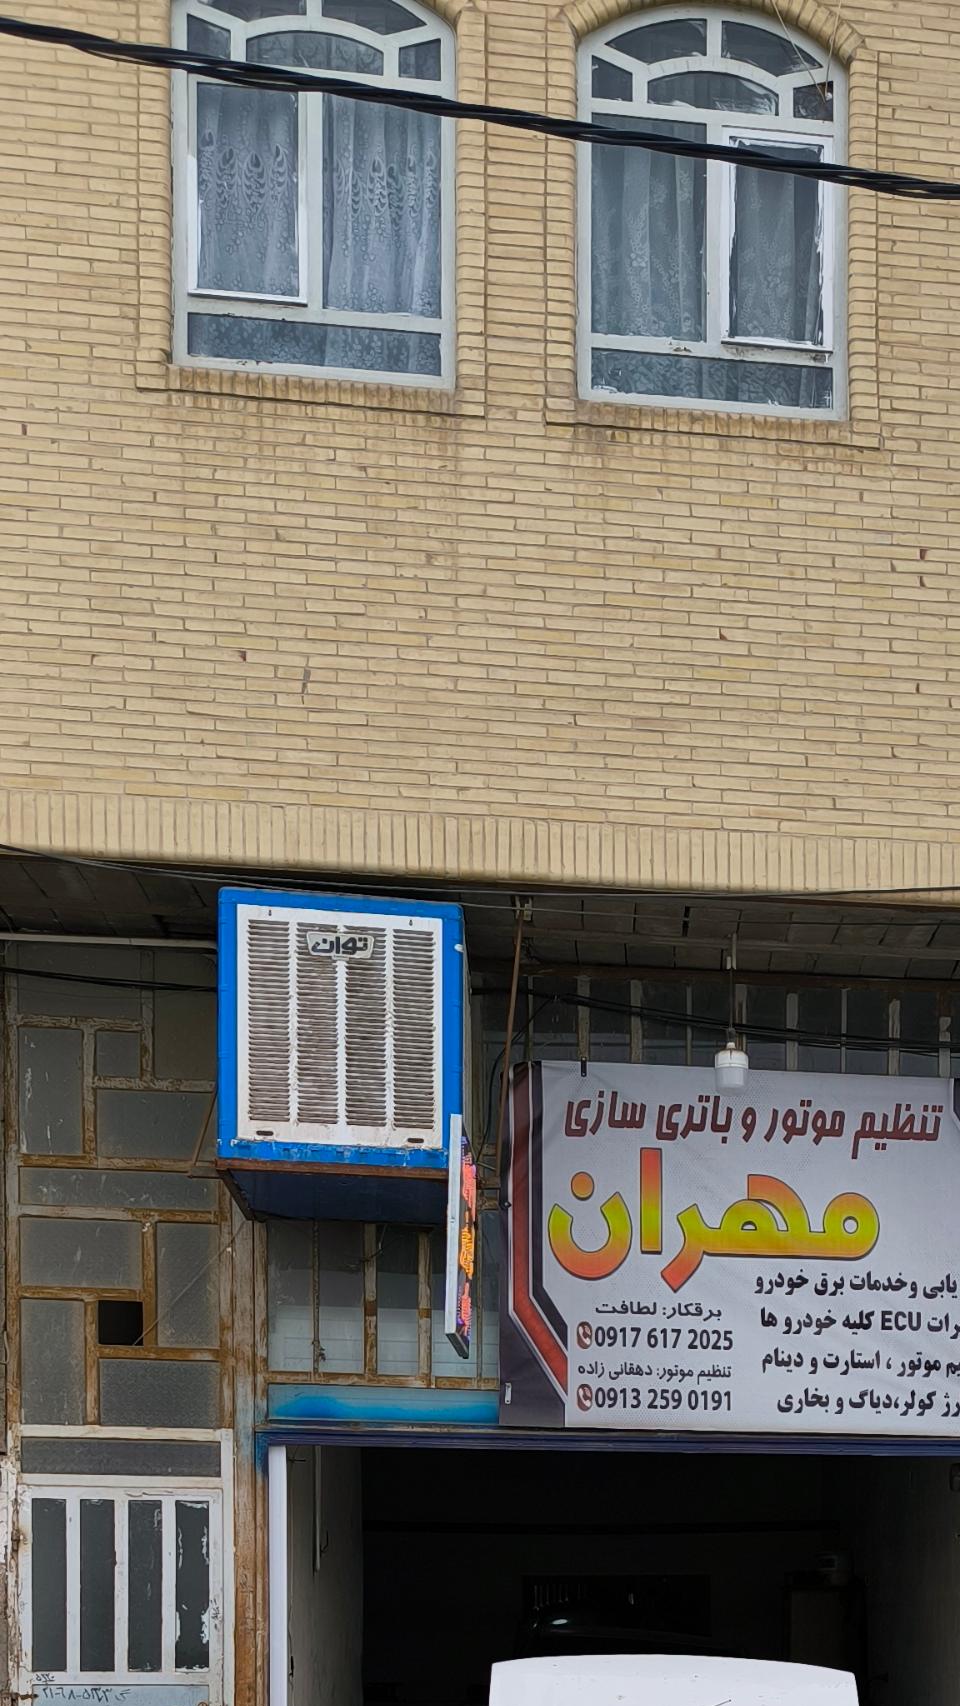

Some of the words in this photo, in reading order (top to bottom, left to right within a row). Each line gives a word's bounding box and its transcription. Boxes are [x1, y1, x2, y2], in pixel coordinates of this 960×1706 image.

[311, 936, 368, 955] توان
[565, 1090, 646, 1137] سازی
[656, 1095, 733, 1144] باتری
[741, 1107, 756, 1143] و
[764, 1100, 845, 1145] موتور
[852, 1103, 943, 1159] تنظیم
[547, 1148, 880, 1293] مهران
[754, 1269, 809, 1295] خودرو
[814, 1273, 844, 1296] برق
[923, 1273, 957, 1299] یابی
[596, 1301, 656, 1315] لطافت
[761, 1307, 777, 1327] ها
[783, 1309, 836, 1335] خودرو
[842, 1310, 875, 1335] کلیه
[881, 1311, 921, 1331] ECU
[595, 1326, 641, 1347] 0917
[647, 1328, 681, 1348] 617
[688, 1329, 733, 1350] 2025
[578, 1361, 604, 1378] زاده
[609, 1362, 652, 1380] دهقانی
[762, 1347, 803, 1373] دینام
[809, 1357, 818, 1374] و
[823, 1349, 880, 1375] استارت
[897, 1352, 941, 1377] موتور
[697, 1365, 731, 1385] تنظیم
[595, 1387, 641, 1408] 0913
[647, 1389, 682, 1409] 259
[688, 1390, 730, 1411] 0191
[777, 1388, 829, 1413] بخاری
[835, 1397, 843, 1414] و
